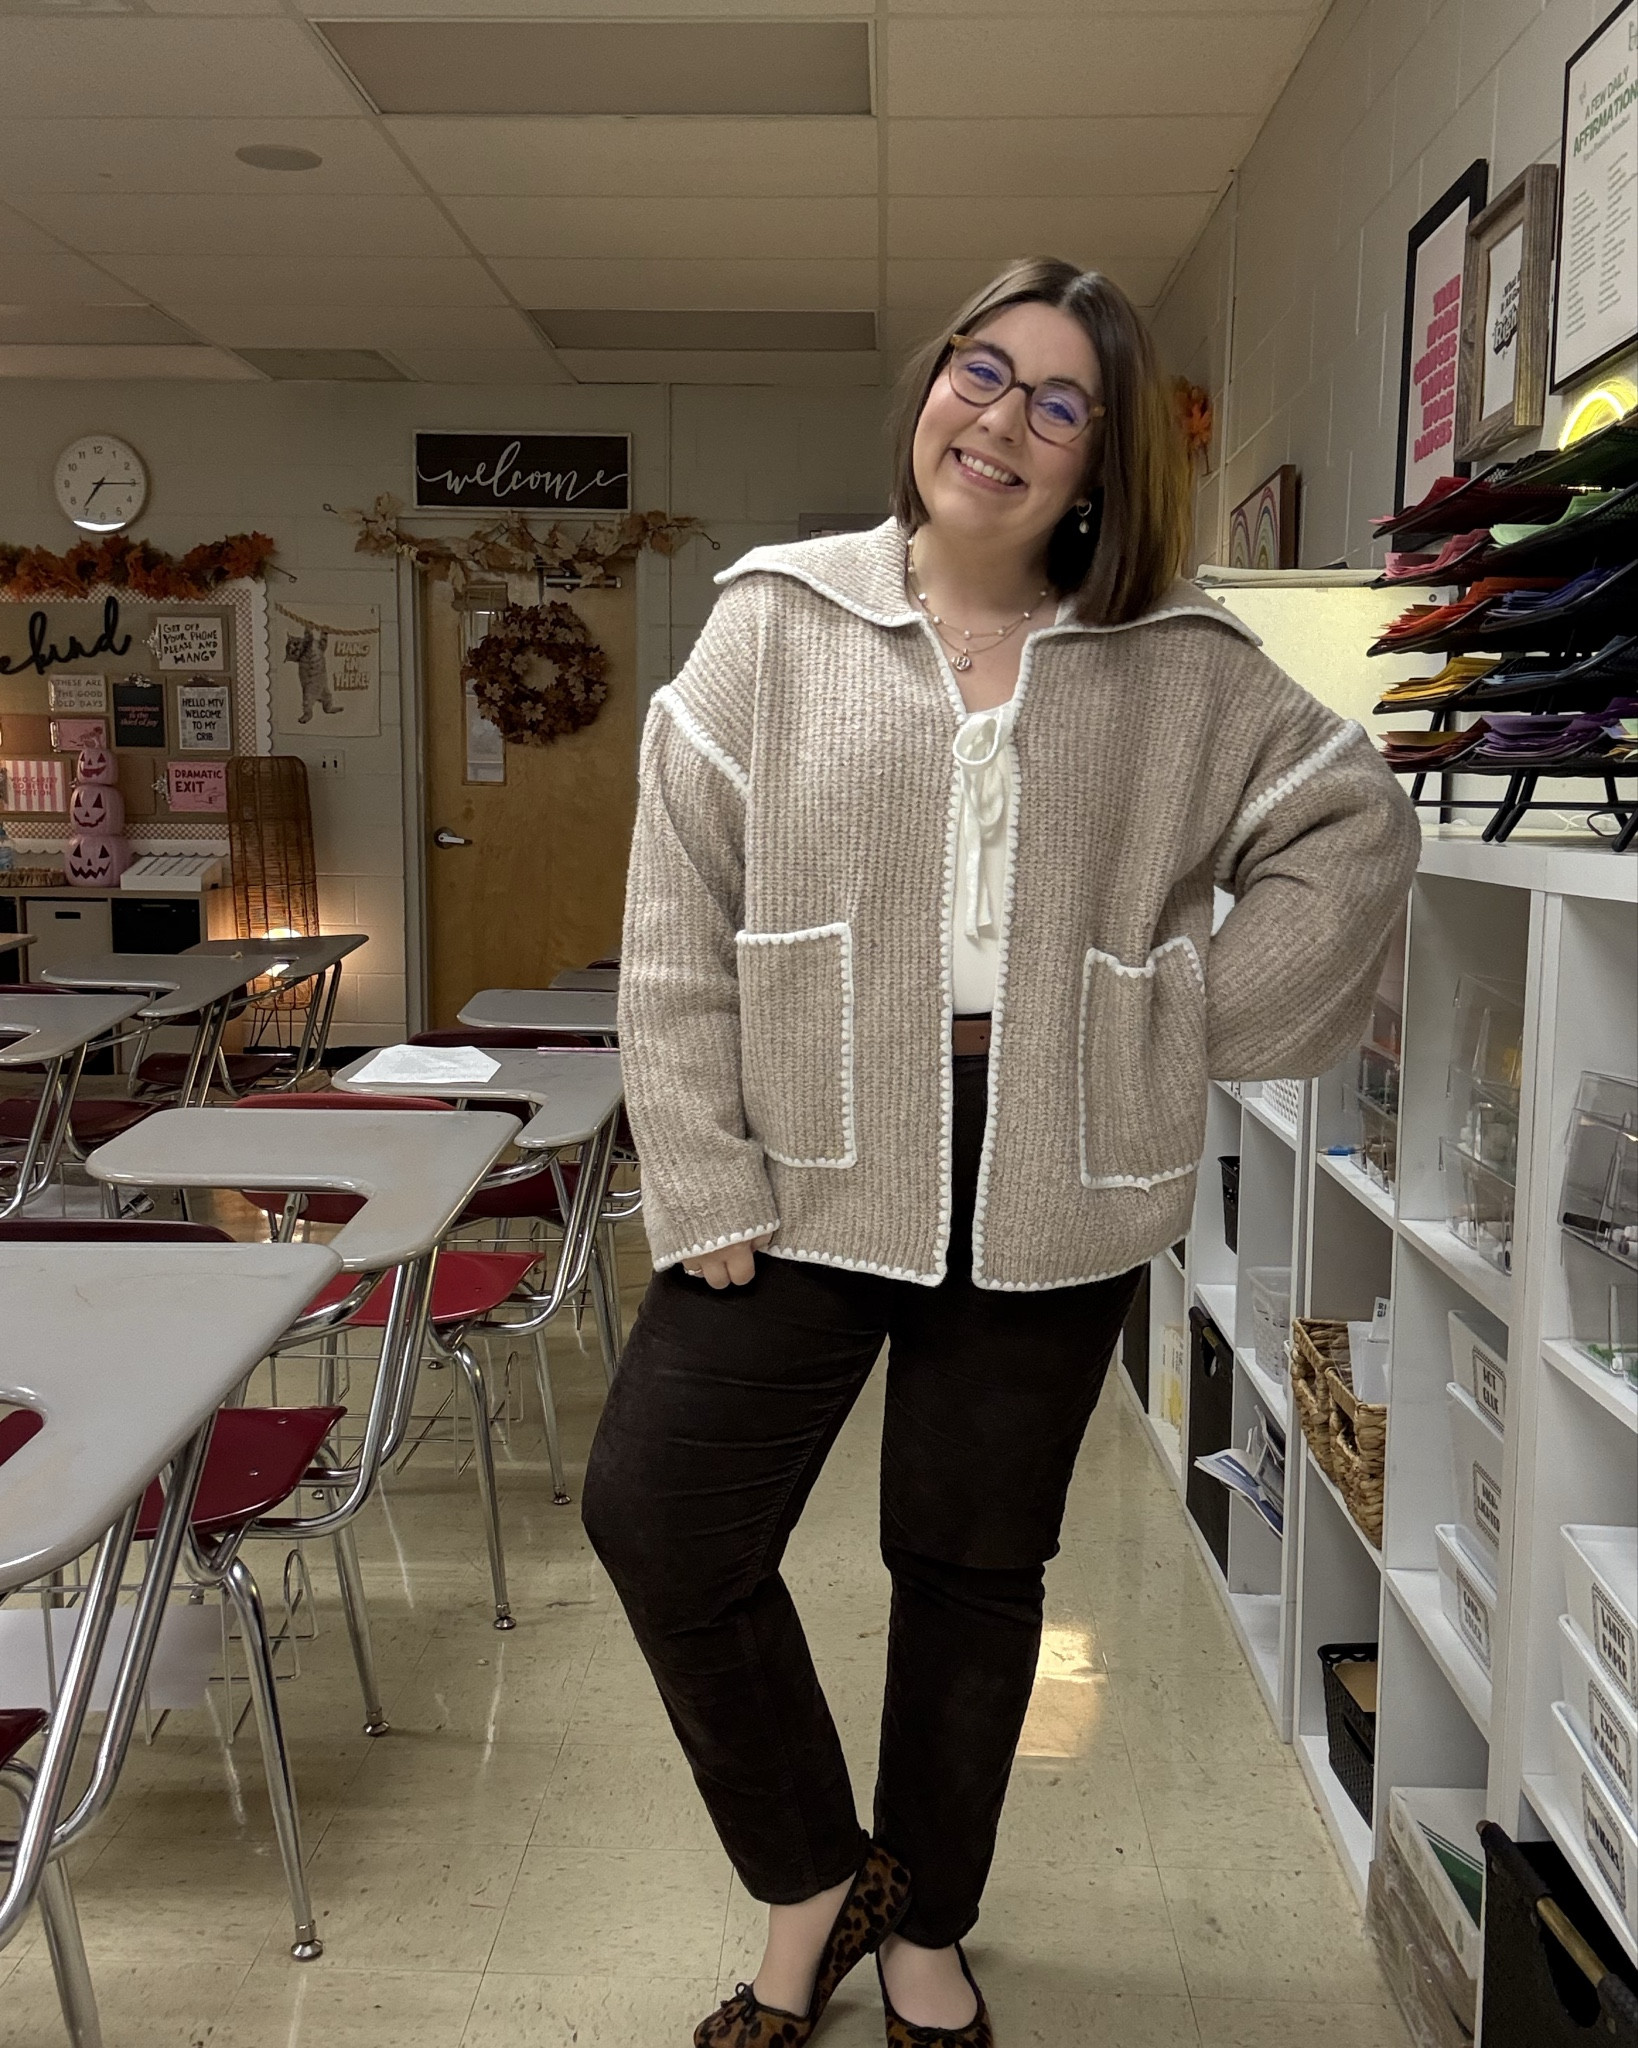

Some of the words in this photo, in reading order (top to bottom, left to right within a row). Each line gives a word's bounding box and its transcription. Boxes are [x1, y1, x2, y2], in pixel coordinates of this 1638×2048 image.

[1591, 88, 1607, 115] FEW
[1607, 65, 1629, 98] DAILY
[93, 445, 103, 454] 12
[78, 451, 86, 459] 11
[67, 463, 77, 472] 10
[417, 441, 628, 501] welcome
[163, 624, 180, 633] GET
[184, 623, 199, 631] OFF
[163, 633, 187, 644] YOUR
[190, 630, 217, 640] PHONE
[163, 642, 192, 654] PLEASE
[198, 641, 218, 650] AND
[334, 640, 370, 657] HANG
[56, 700, 75, 708] OLD
[79, 700, 103, 708] DAYS
[182, 698, 205, 707] HELLO
[207, 698, 224, 708] MTV
[185, 709, 222, 719] WELCOME
[192, 720, 202, 730] TO
[204, 720, 217, 730] MY
[196, 732, 213, 741] CRIB
[174, 769, 223, 779] DRAMATIC
[175, 781, 205, 793] EXIT
[1601, 1606, 1627, 1656] WHITE
[1602, 1633, 1628, 1682] PAPER
[1600, 1712, 1620, 1753] EXPO
